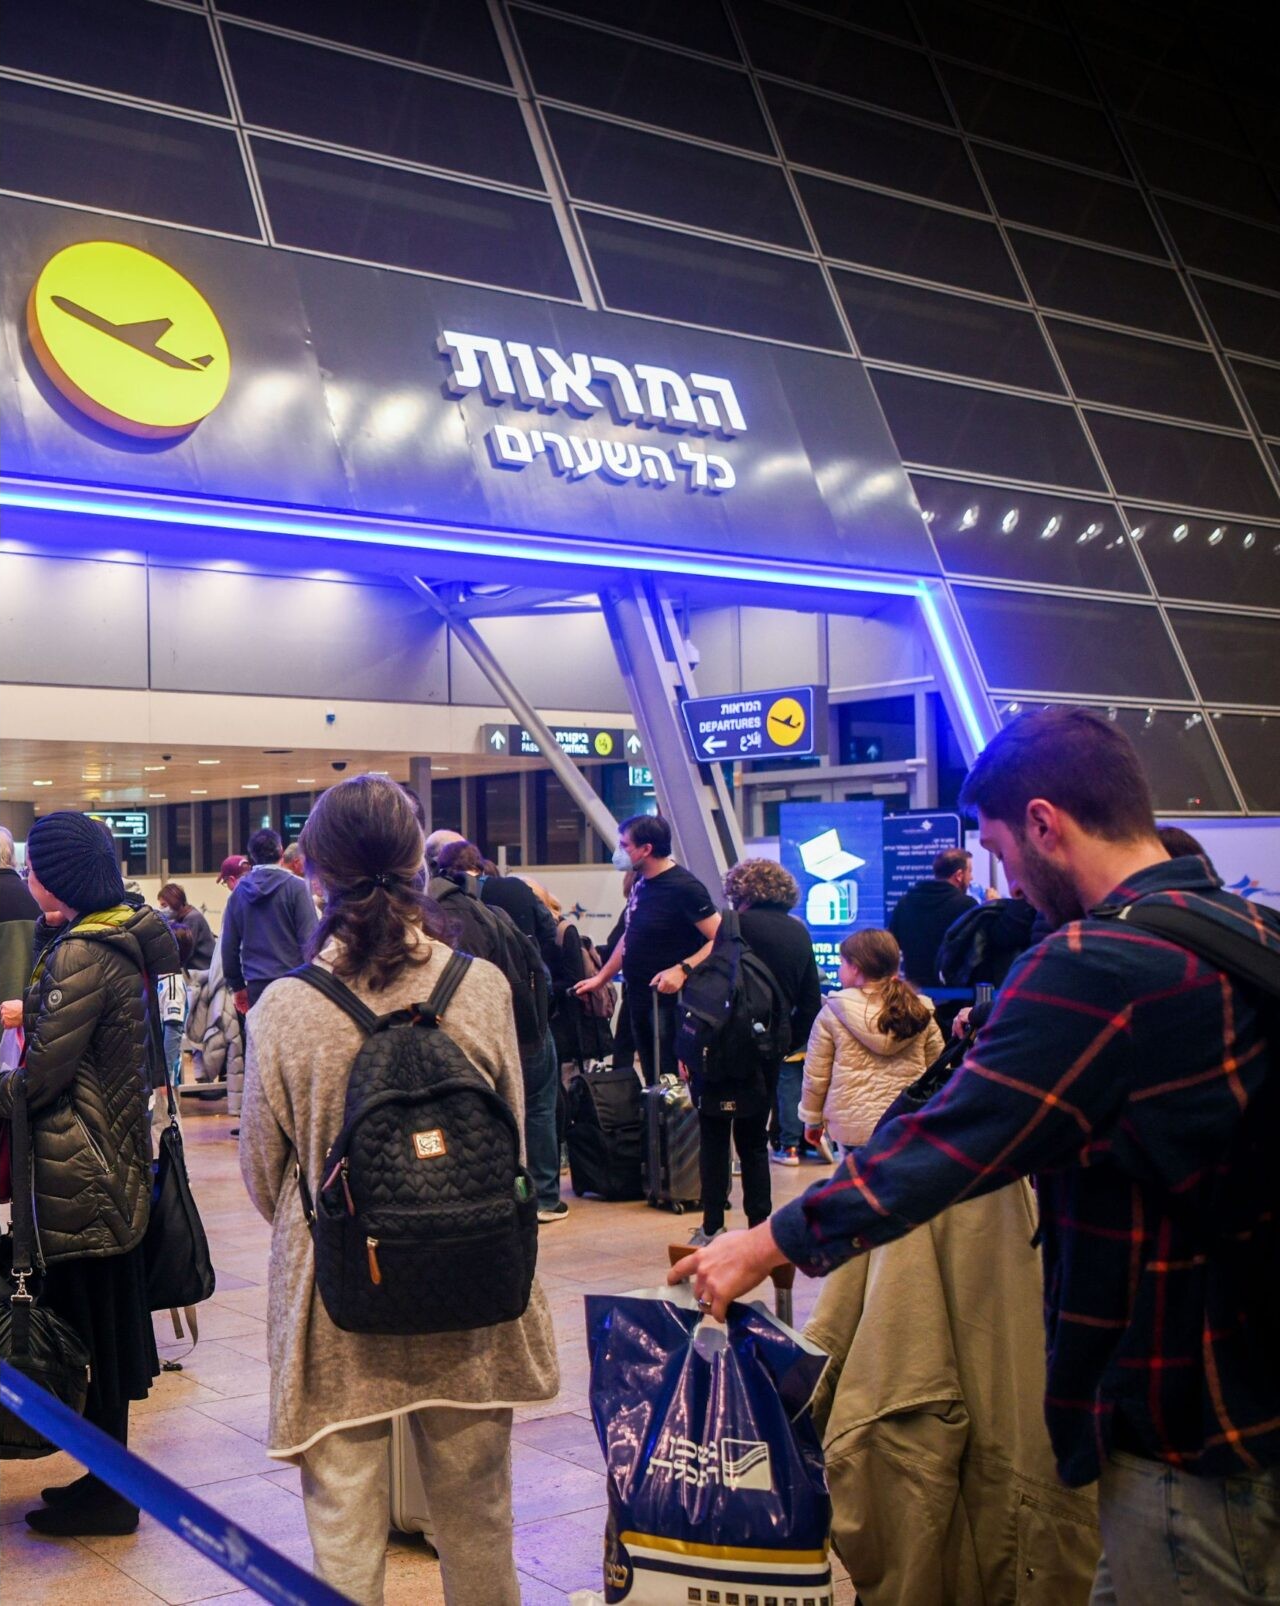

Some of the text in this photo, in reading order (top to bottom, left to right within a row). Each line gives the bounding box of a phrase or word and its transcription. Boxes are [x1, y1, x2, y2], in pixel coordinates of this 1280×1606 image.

[440, 330, 748, 432] המראות
[493, 424, 737, 489] כל השערים
[720, 700, 761, 715] המראות
[699, 716, 761, 733] DEPARTURES
[560, 743, 590, 755] ONTROL
